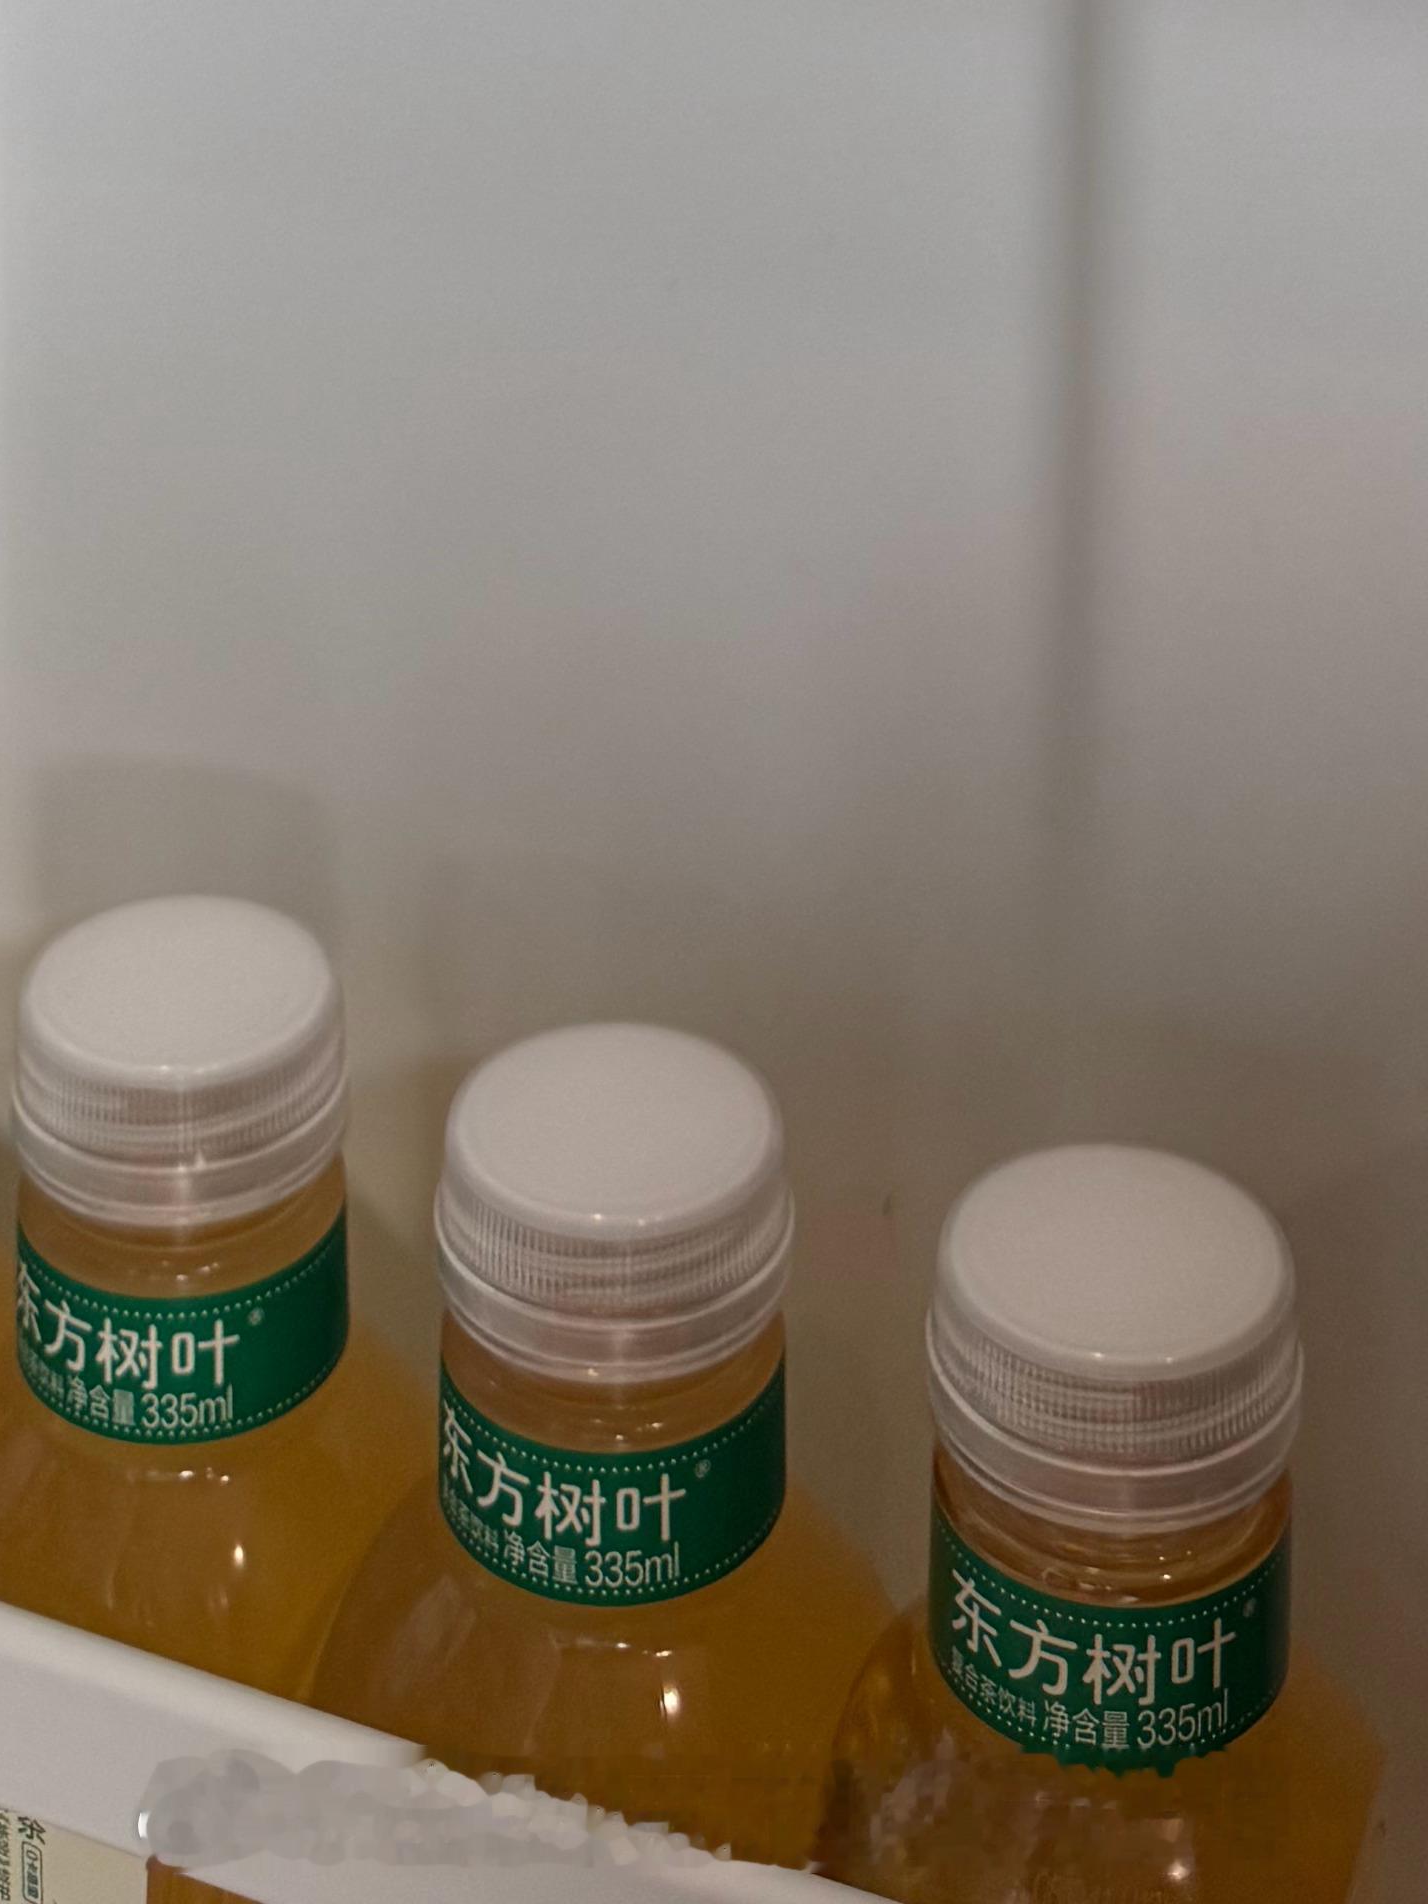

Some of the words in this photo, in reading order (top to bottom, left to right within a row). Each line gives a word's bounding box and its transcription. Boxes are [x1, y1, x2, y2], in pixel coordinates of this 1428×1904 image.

[18, 1262, 240, 1390] 东方树叶
[69, 1376, 134, 1426] 净含量
[142, 1385, 233, 1428] 335ml
[443, 1399, 686, 1546] 东方树叶
[504, 1530, 577, 1585] 净含量
[585, 1542, 679, 1587] 335ml
[953, 1569, 1236, 1706] 东方树叶
[1044, 1700, 1129, 1749] 净含量
[1138, 1689, 1228, 1749] 335ml
